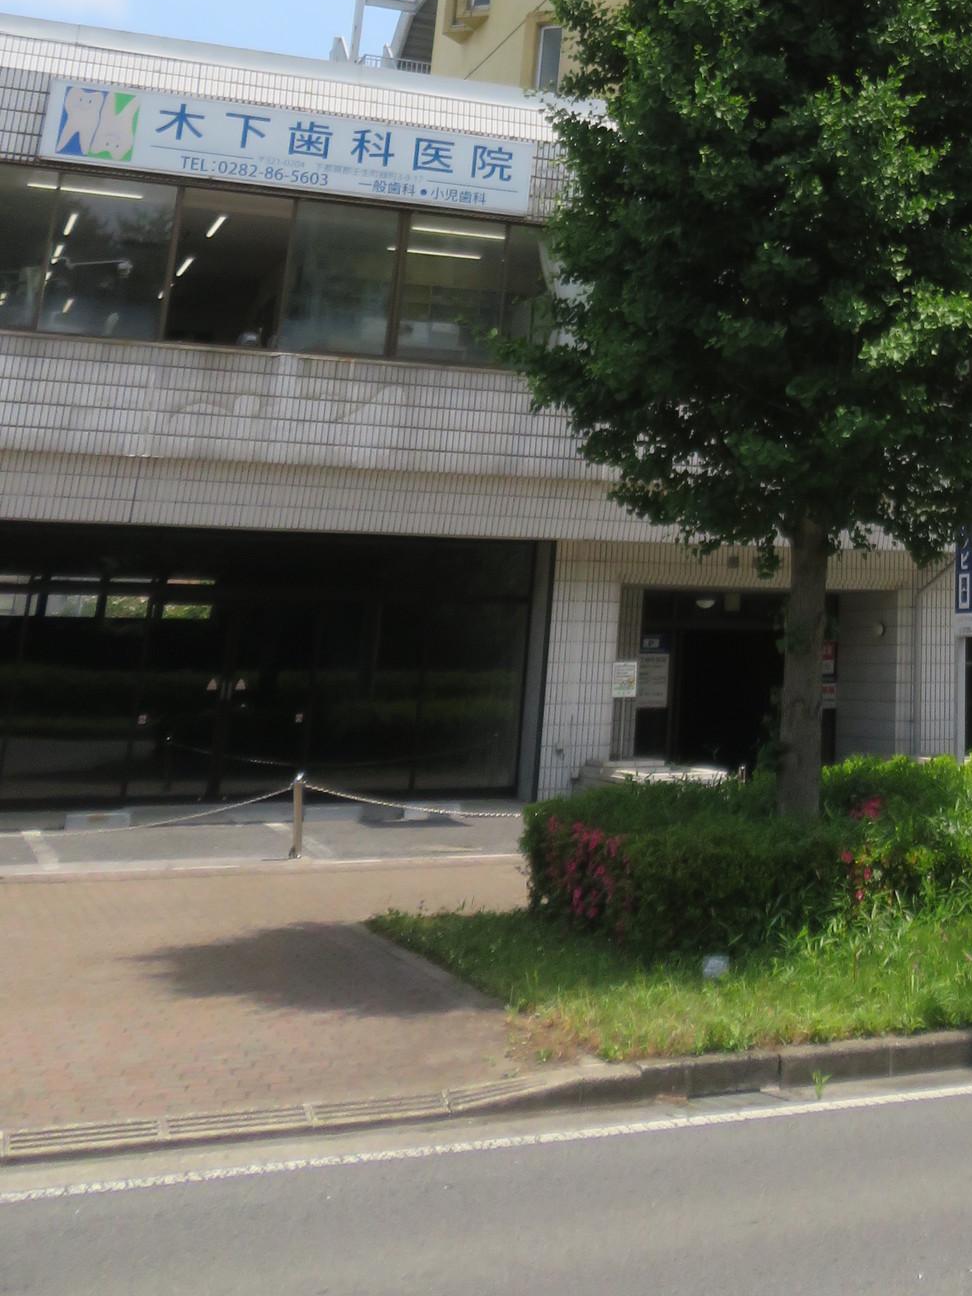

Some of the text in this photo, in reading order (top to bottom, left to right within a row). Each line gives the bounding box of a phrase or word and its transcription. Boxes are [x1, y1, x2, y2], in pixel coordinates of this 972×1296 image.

[155, 103, 514, 182] 木下歯科医院
